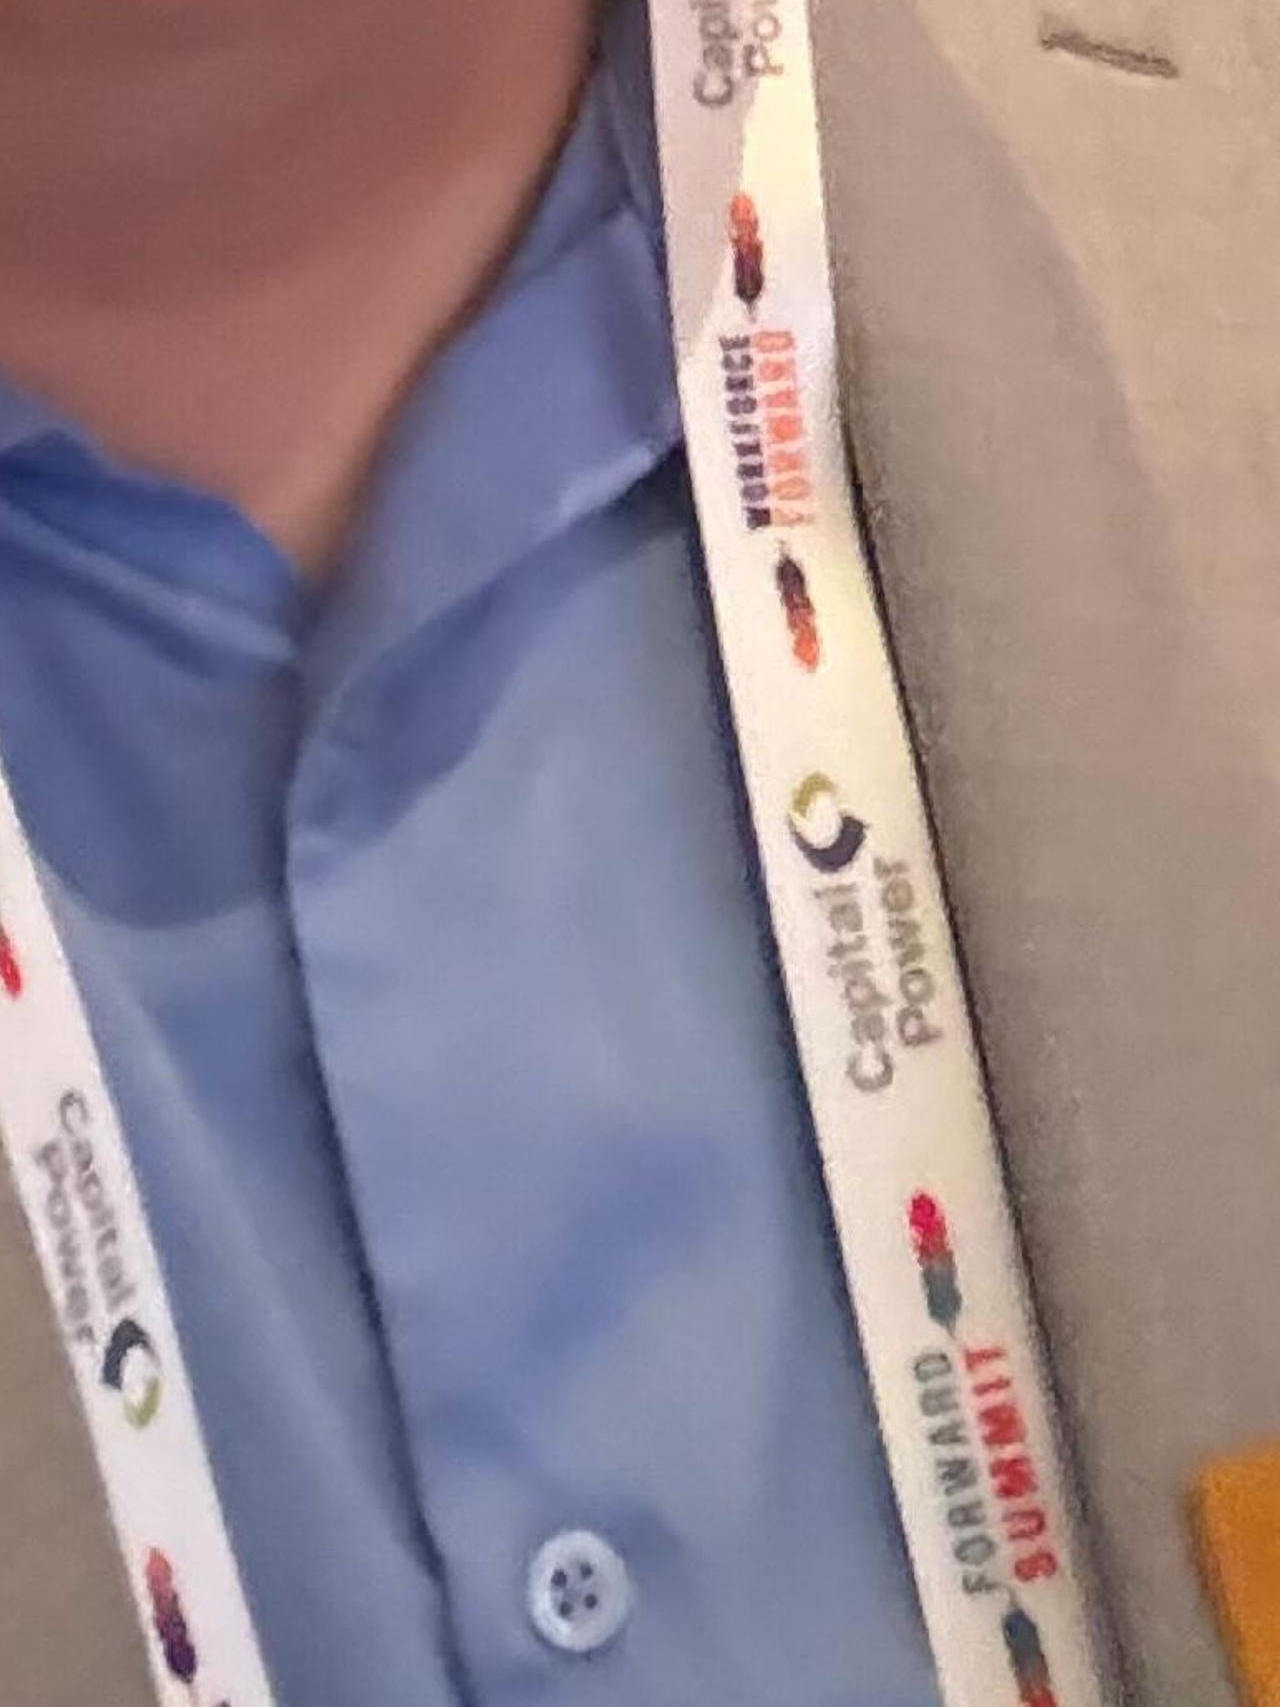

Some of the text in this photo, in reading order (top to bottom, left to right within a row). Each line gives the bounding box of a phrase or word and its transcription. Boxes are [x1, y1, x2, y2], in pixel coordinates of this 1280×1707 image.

[720, 333, 771, 531] WORKFORCE
[754, 330, 813, 528] FORWARD
[813, 883, 894, 1093] Capital
[874, 857, 942, 1048] Power
[34, 1139, 95, 1345] Power
[59, 1089, 136, 1314] Capital
[913, 1350, 998, 1597] FORWARD
[964, 1344, 1058, 1583] SUMMIT
